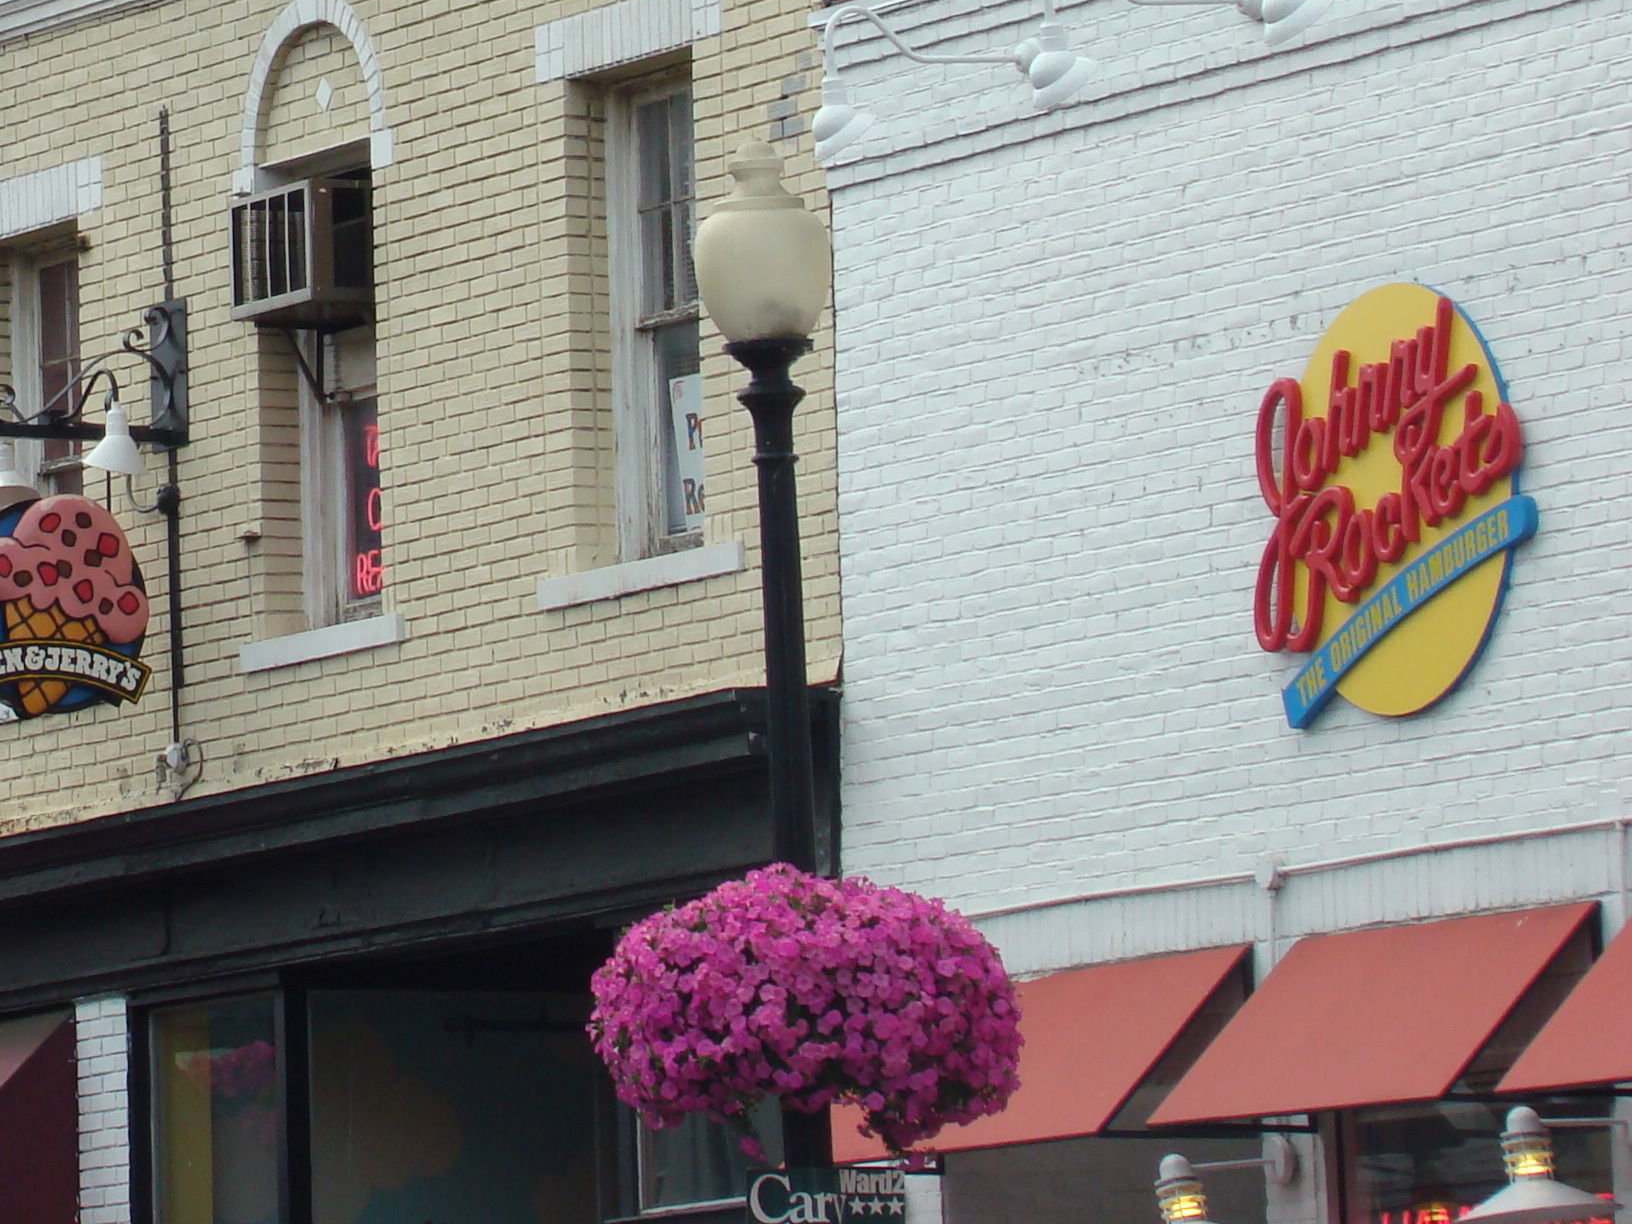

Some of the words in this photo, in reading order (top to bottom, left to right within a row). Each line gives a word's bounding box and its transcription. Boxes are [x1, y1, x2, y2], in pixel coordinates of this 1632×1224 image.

[1255, 296, 1478, 653] Johnny
[1283, 390, 1522, 652] Rockets
[1296, 656, 1327, 706] THE
[1329, 586, 1402, 672] ORIGINAL
[1406, 510, 1509, 602] HAMBURGER
[750, 1173, 847, 1224] Cary
